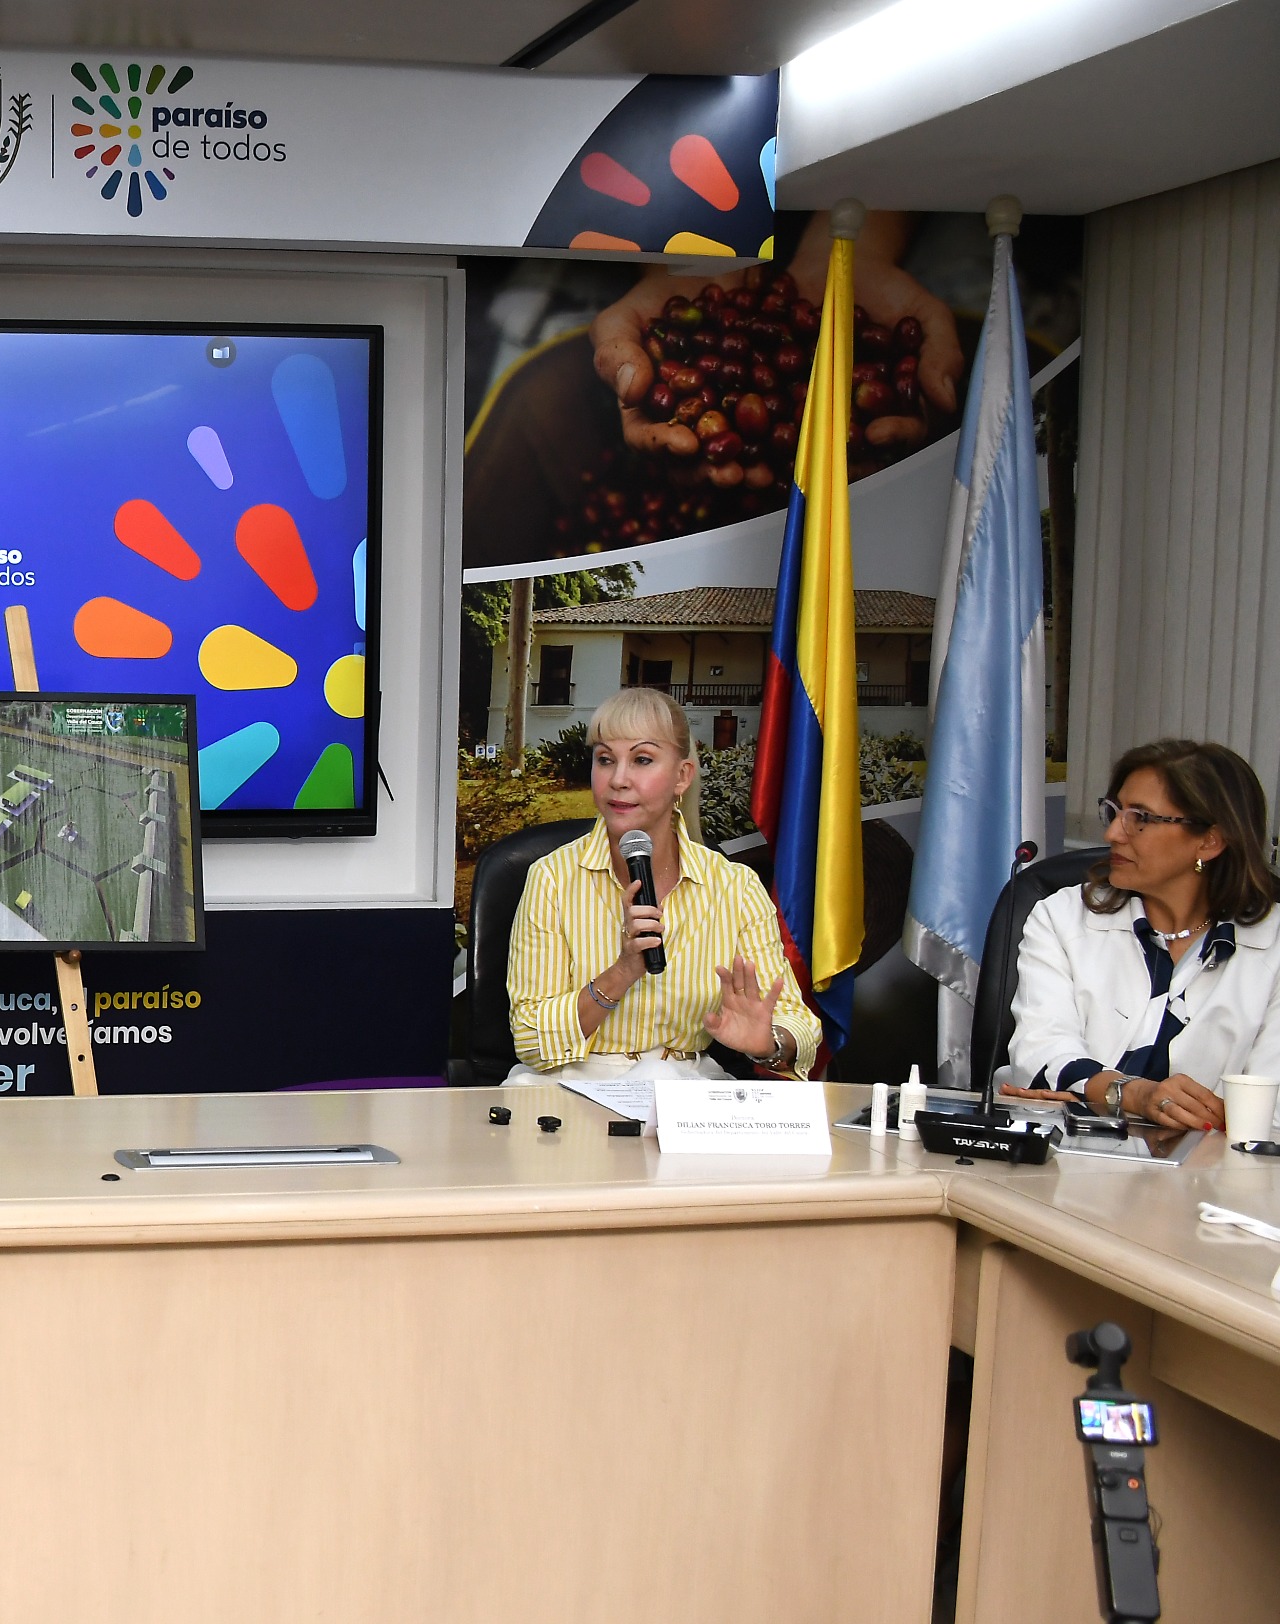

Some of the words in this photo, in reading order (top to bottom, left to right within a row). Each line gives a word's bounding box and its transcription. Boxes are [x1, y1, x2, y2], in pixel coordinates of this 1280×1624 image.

[152, 101, 268, 133] paraíso
[152, 131, 190, 159] de
[201, 133, 287, 162] todos
[95, 983, 202, 1017] paraíso
